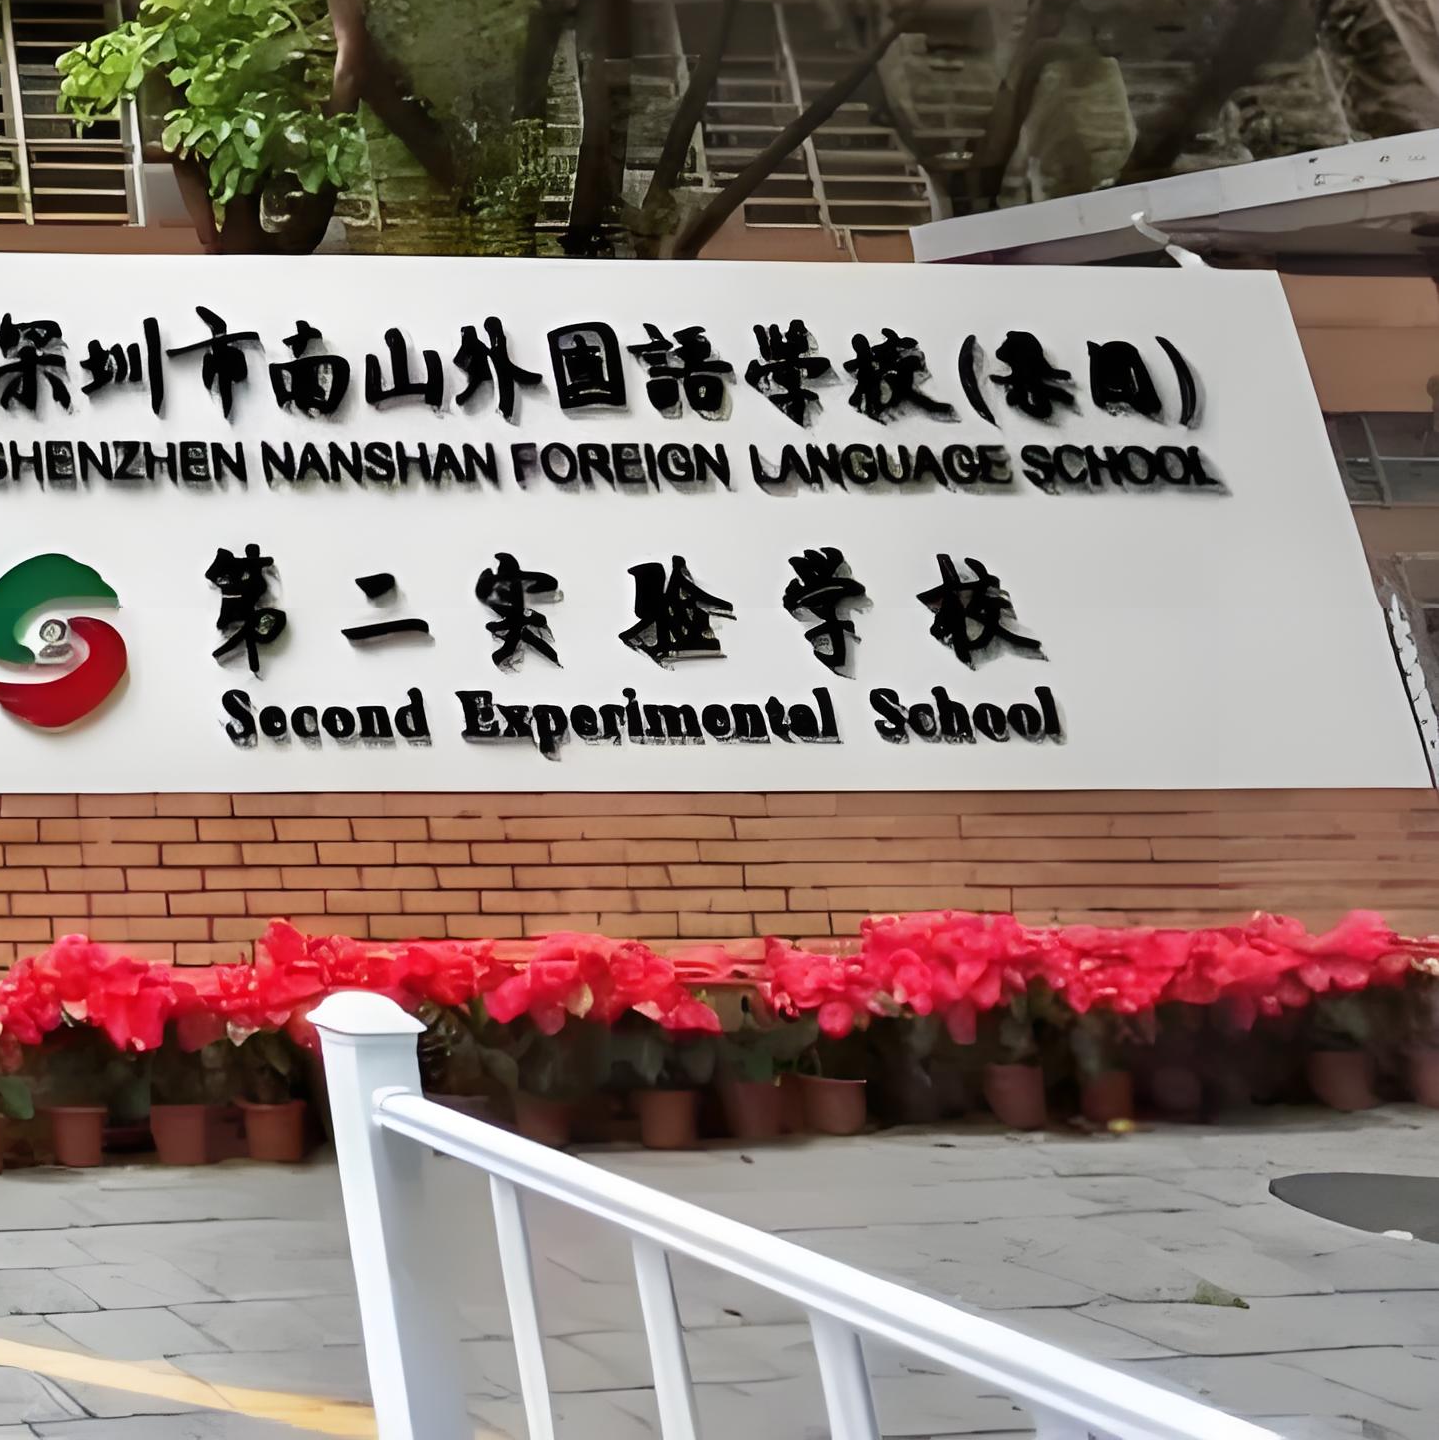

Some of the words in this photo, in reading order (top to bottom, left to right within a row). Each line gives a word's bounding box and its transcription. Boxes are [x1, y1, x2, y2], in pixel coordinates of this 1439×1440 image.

[260, 441, 500, 488] NANSHAN
[510, 442, 731, 490] FOREIGN
[748, 443, 1014, 491] LANGUAGE
[1020, 445, 1221, 493] SCHOOL
[205, 543, 1044, 676] 第二实验学校
[221, 687, 430, 745] Second
[455, 686, 840, 757] Experimental
[869, 685, 1062, 744] School
